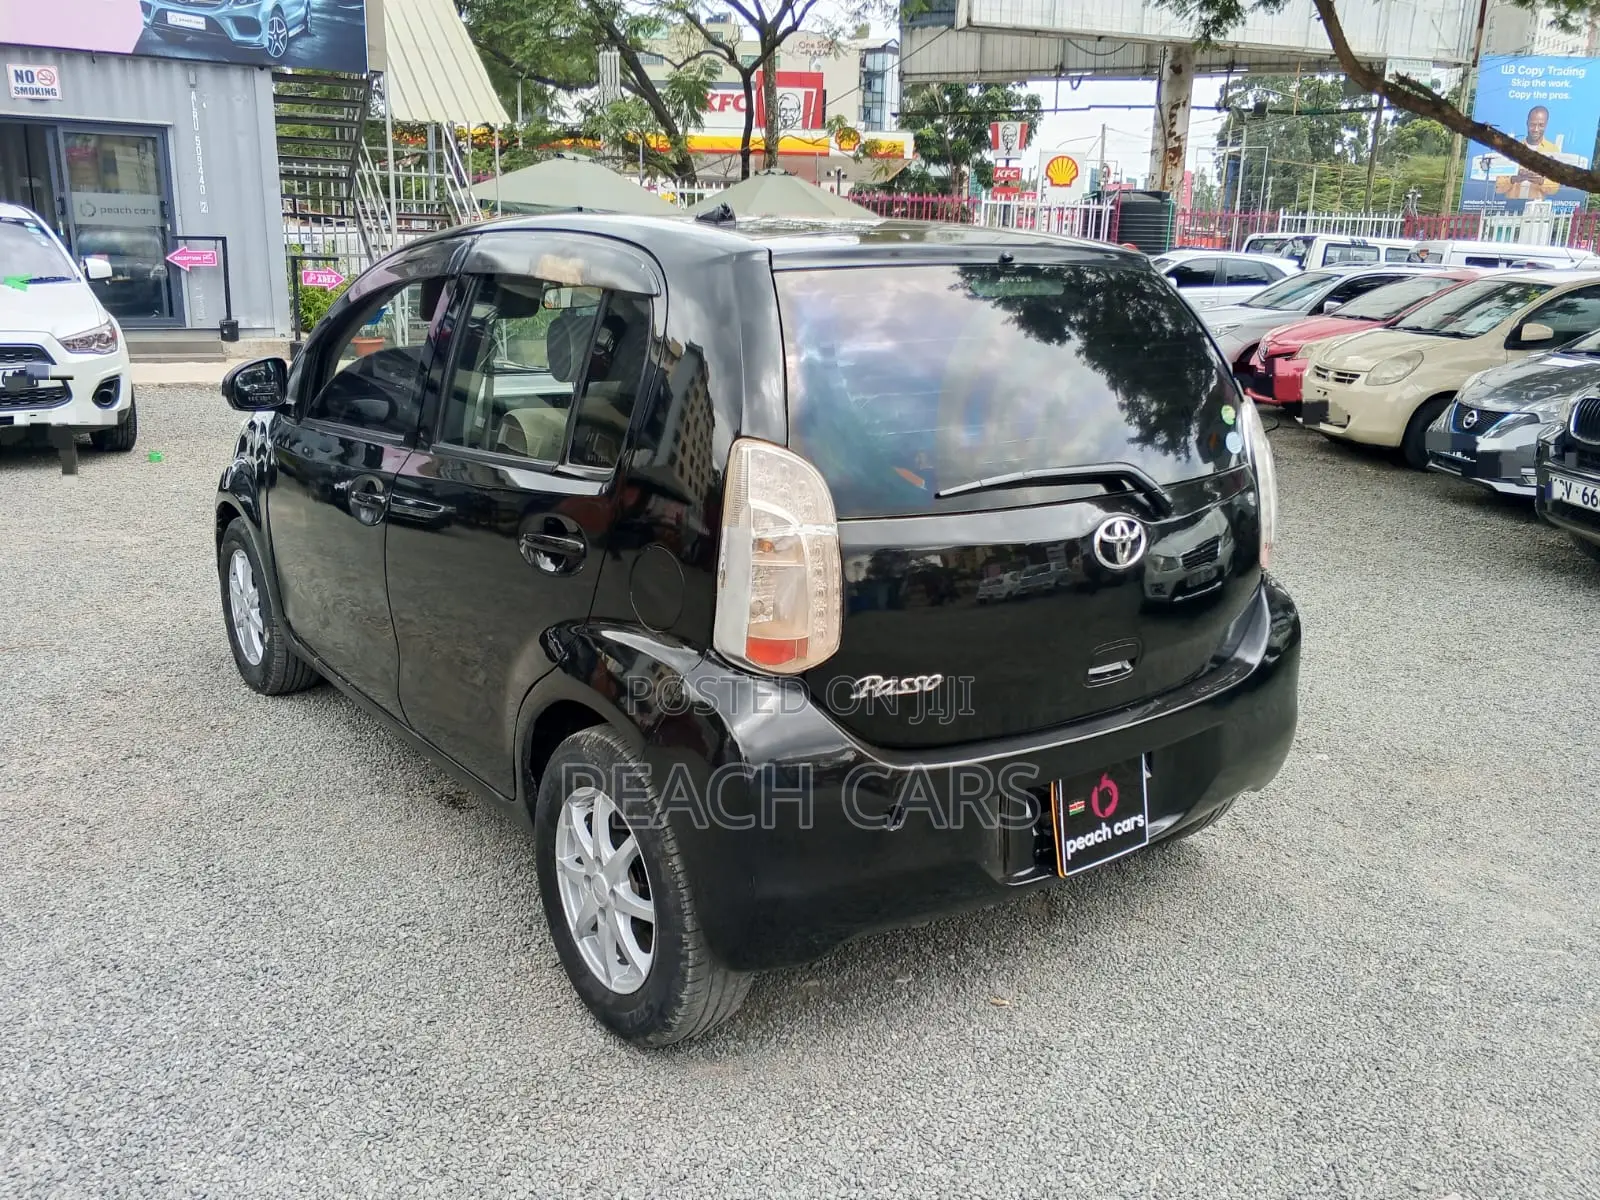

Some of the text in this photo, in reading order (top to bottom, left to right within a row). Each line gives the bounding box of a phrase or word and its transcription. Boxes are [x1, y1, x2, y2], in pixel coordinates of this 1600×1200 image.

[14, 69, 35, 84] NO
[1518, 65, 1544, 77] Copy
[1548, 66, 1586, 79] Trading
[1511, 79, 1529, 88] Skip
[1531, 79, 1546, 87] the
[14, 86, 57, 97] SMOKING
[1509, 90, 1531, 100] Copy
[1533, 91, 1547, 99] the
[703, 93, 746, 113] KFC
[995, 170, 1019, 178] KFC
[100, 206, 156, 215] peach cars
[850, 674, 944, 699] Passo
[1066, 814, 1145, 861] peach cars
